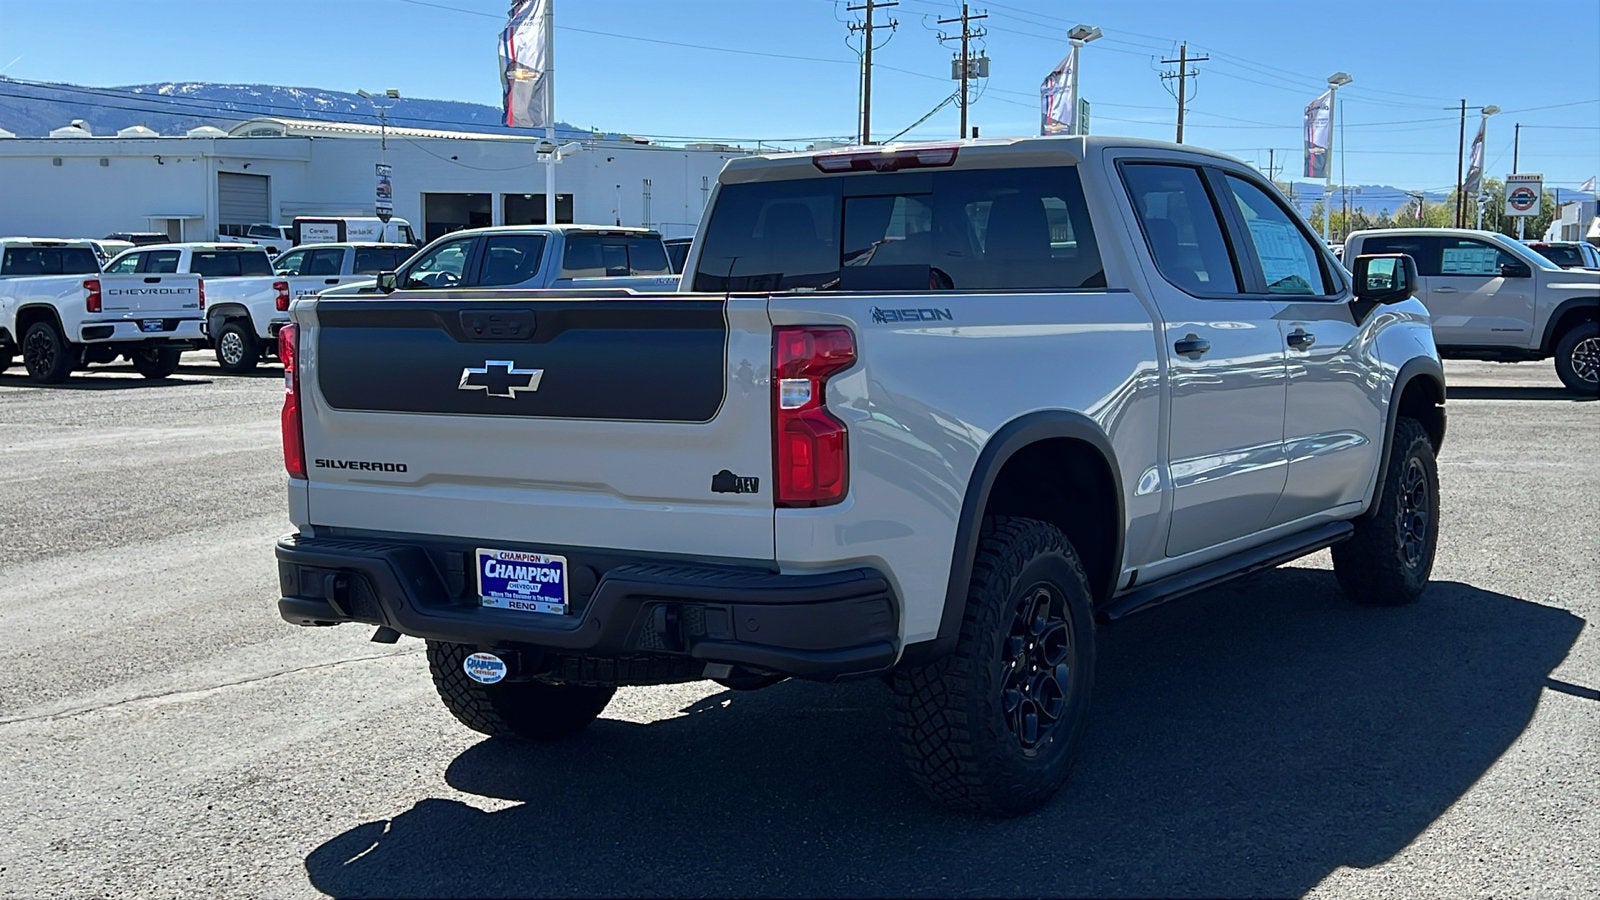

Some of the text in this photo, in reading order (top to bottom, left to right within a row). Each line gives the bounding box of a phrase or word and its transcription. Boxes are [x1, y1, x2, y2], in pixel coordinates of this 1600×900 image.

[882, 307, 953, 322] BISON
[315, 458, 408, 473] SILVERADO
[499, 551, 541, 563] CHAMPION
[484, 560, 561, 584] CHAMPION
[508, 581, 539, 592] CHEVROLET
[508, 601, 537, 611] RENO
